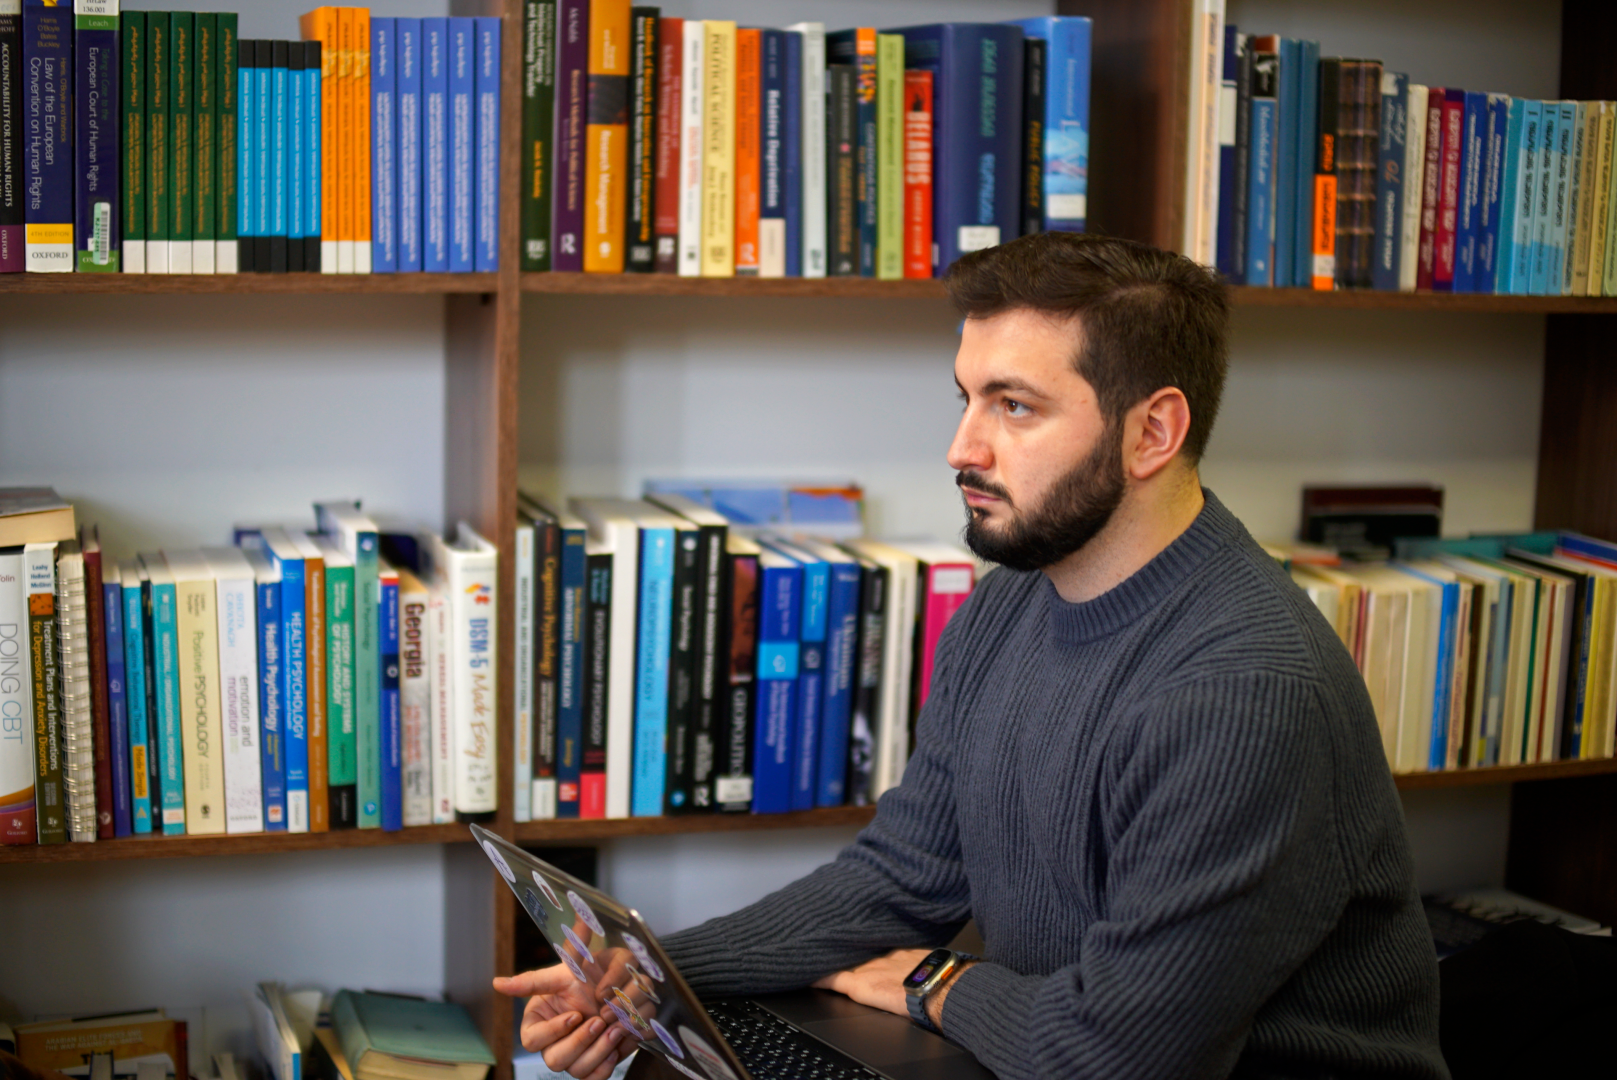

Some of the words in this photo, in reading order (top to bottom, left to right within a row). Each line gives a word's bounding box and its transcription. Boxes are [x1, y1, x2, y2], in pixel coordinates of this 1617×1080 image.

[88, 19, 109, 27] Leach
[2, 42, 11, 118] ACCOUNTABILITY
[44, 57, 55, 80] Law
[87, 47, 99, 88] European
[711, 33, 722, 96] POLITICAL
[31, 57, 42, 118] Convention
[45, 82, 56, 93] of
[45, 95, 56, 112] the
[89, 90, 99, 117] Court
[3, 120, 12, 137] FOR
[31, 119, 40, 133] on
[89, 119, 99, 130] of
[710, 101, 721, 153] SCIENCE
[767, 89, 780, 138] Relative
[4, 139, 12, 172] HUMAN
[31, 136, 42, 174] Human
[43, 115, 56, 165] European
[89, 131, 99, 162] Human
[906, 111, 931, 185] BELARUS
[1029, 120, 1041, 162] PUBLIC
[4, 174, 13, 207] RIGHTS
[29, 177, 42, 209] Rights
[86, 165, 99, 192] Rights
[765, 139, 780, 207] Deprivation
[1028, 164, 1041, 208] POLICY
[32, 251, 68, 259] OXFORD
[541, 557, 557, 612] Cognitive
[32, 621, 43, 633] for
[225, 592, 235, 647] CAVANAGH
[235, 592, 245, 629] SHIOTA
[331, 623, 342, 637] OF
[563, 587, 574, 641] ABNORMAL
[678, 610, 692, 652] Psychology
[43, 619, 55, 667] Treatment
[192, 631, 205, 674] Positive
[265, 623, 278, 665] Health
[291, 612, 302, 657] HEALTH
[340, 622, 351, 666] HISTORY
[403, 602, 426, 679] Georgia
[469, 617, 489, 668] DSM-5
[539, 614, 556, 678] Psychology
[592, 610, 606, 682] EVOLUTIONARY
[644, 580, 658, 701] NEUROPSYCHOLOGY
[0, 623, 20, 695] DOING
[31, 635, 44, 682] Depression
[45, 668, 55, 691] Plans
[332, 639, 343, 705] PSYCHOLOGY
[341, 666, 352, 688] AND
[561, 643, 573, 709] PSYCHOLOGY
[34, 684, 45, 699] and
[46, 692, 57, 711] and
[227, 676, 240, 737] motivation
[239, 676, 251, 722] emotion
[263, 665, 280, 732] Psychology
[292, 661, 304, 740] PSYCHOLOGY
[342, 689, 353, 734] SYSTEMS
[470, 672, 490, 718] Made
[590, 682, 603, 745] PSYCHOLOGY
[2, 699, 23, 746] CBT
[34, 701, 47, 735] Anxiety
[194, 675, 210, 759] PSYCHOLOGY
[241, 725, 253, 748] and
[37, 736, 49, 776] Disorders
[47, 712, 58, 770] Interventions
[463, 720, 490, 759] Easy
[45, 1043, 57, 1051] THE
[60, 1042, 76, 1050] WAR
[46, 1035, 76, 1044] ARABIAN
